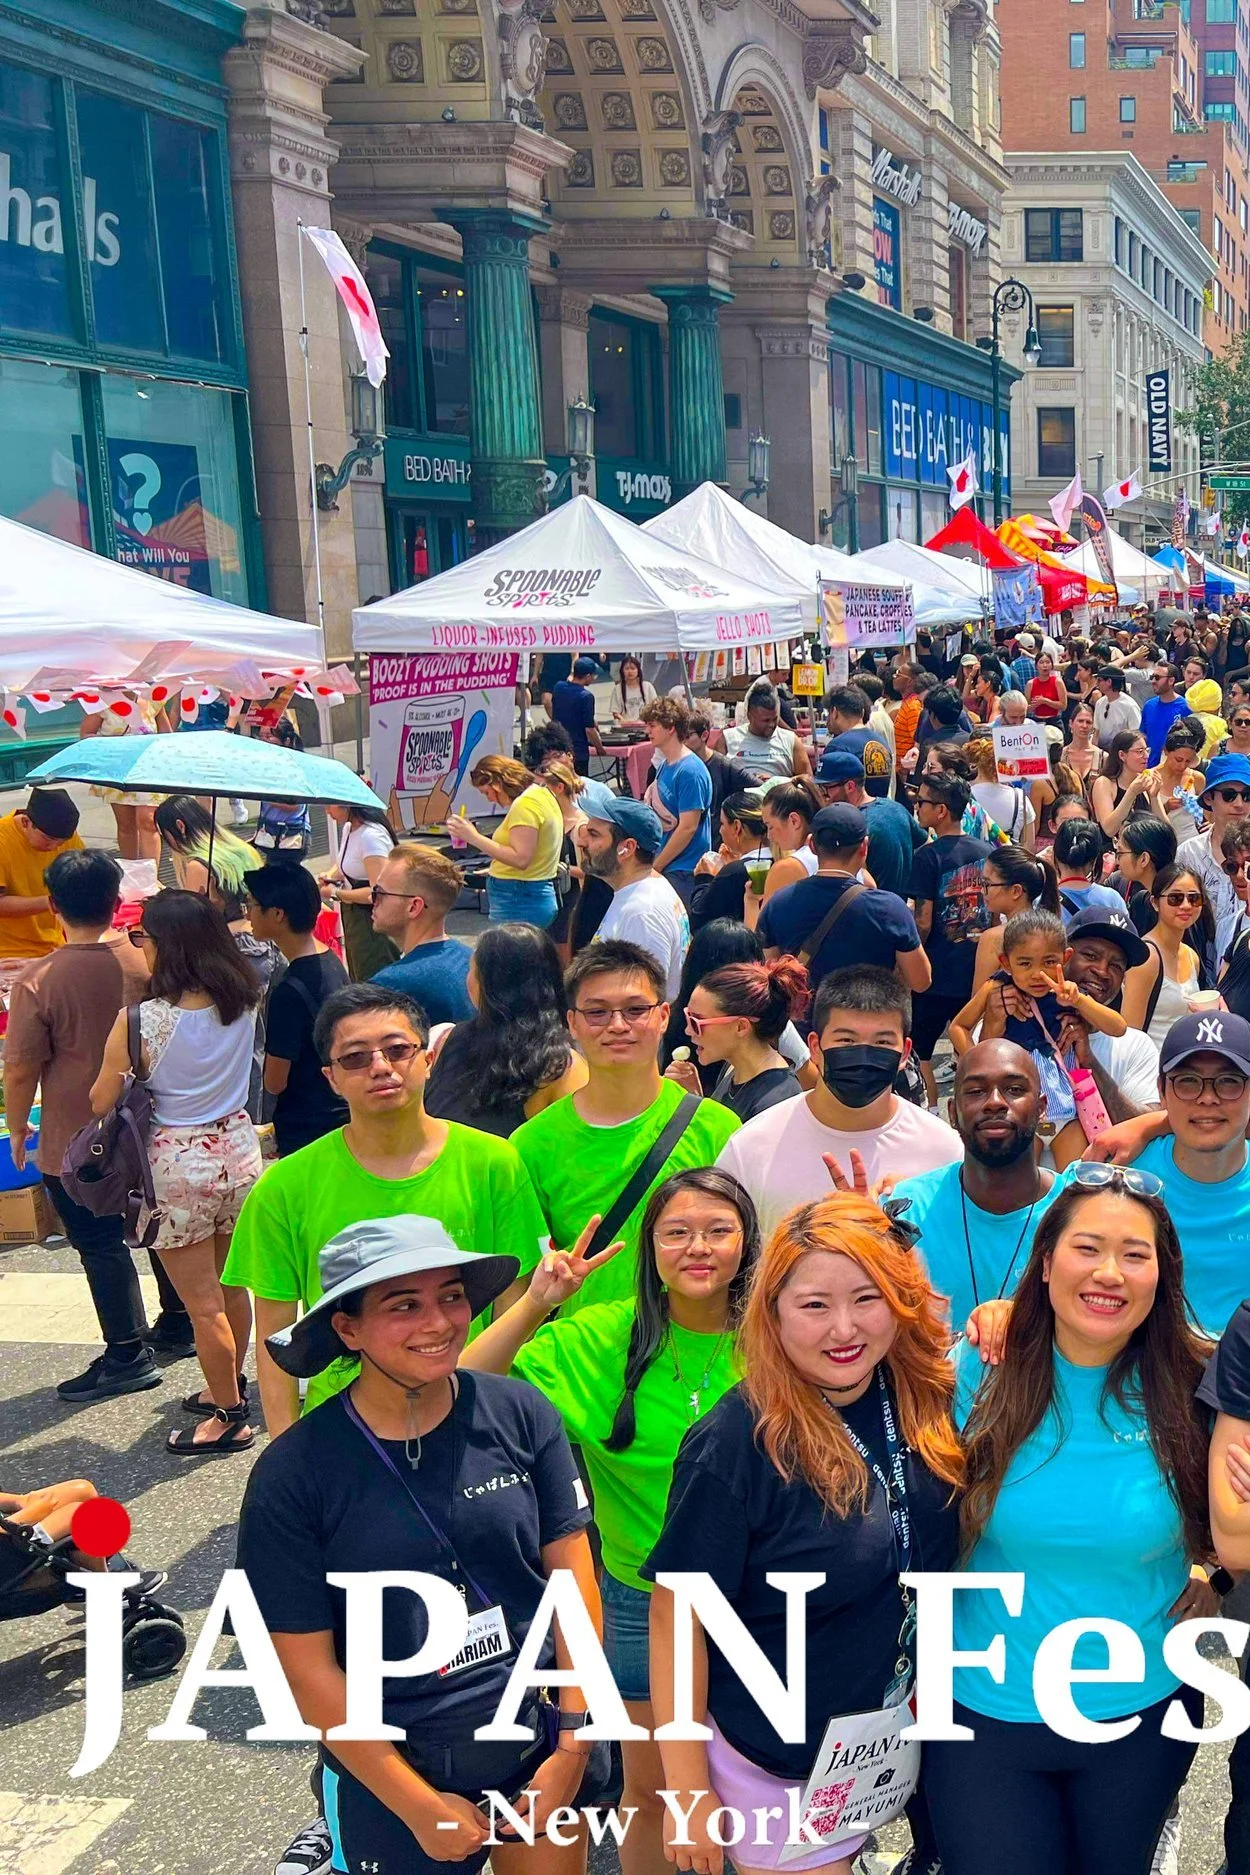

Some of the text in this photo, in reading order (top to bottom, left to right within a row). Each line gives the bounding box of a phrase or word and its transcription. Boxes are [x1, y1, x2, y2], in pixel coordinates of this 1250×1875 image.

[871, 148, 921, 208] Marshalls
[1149, 377, 1168, 467] OLD NAVY
[404, 455, 464, 485] BED BATH
[117, 547, 190, 564] hat Will You
[845, 587, 880, 602] JAPANESE
[716, 611, 771, 641] JELLO SHOTS
[845, 604, 879, 618] PANCAKE,
[864, 620, 877, 633] TEA
[878, 619, 902, 633] LATTES
[542, 624, 596, 647] PUDDING
[372, 652, 512, 685] BOOZY PUDDING SHOTS
[408, 682, 417, 695] IS
[419, 681, 431, 694] IN
[434, 678, 455, 691] THE
[1000, 733, 1039, 747] BentOn
[882, 1400, 897, 1443] dentsu
[825, 1735, 896, 1776] JAPAN
[856, 1762, 870, 1772] New
[870, 1758, 884, 1769] York
[845, 1780, 911, 1810] GENERAL MANAGER
[838, 1793, 905, 1828] MAYUMI
